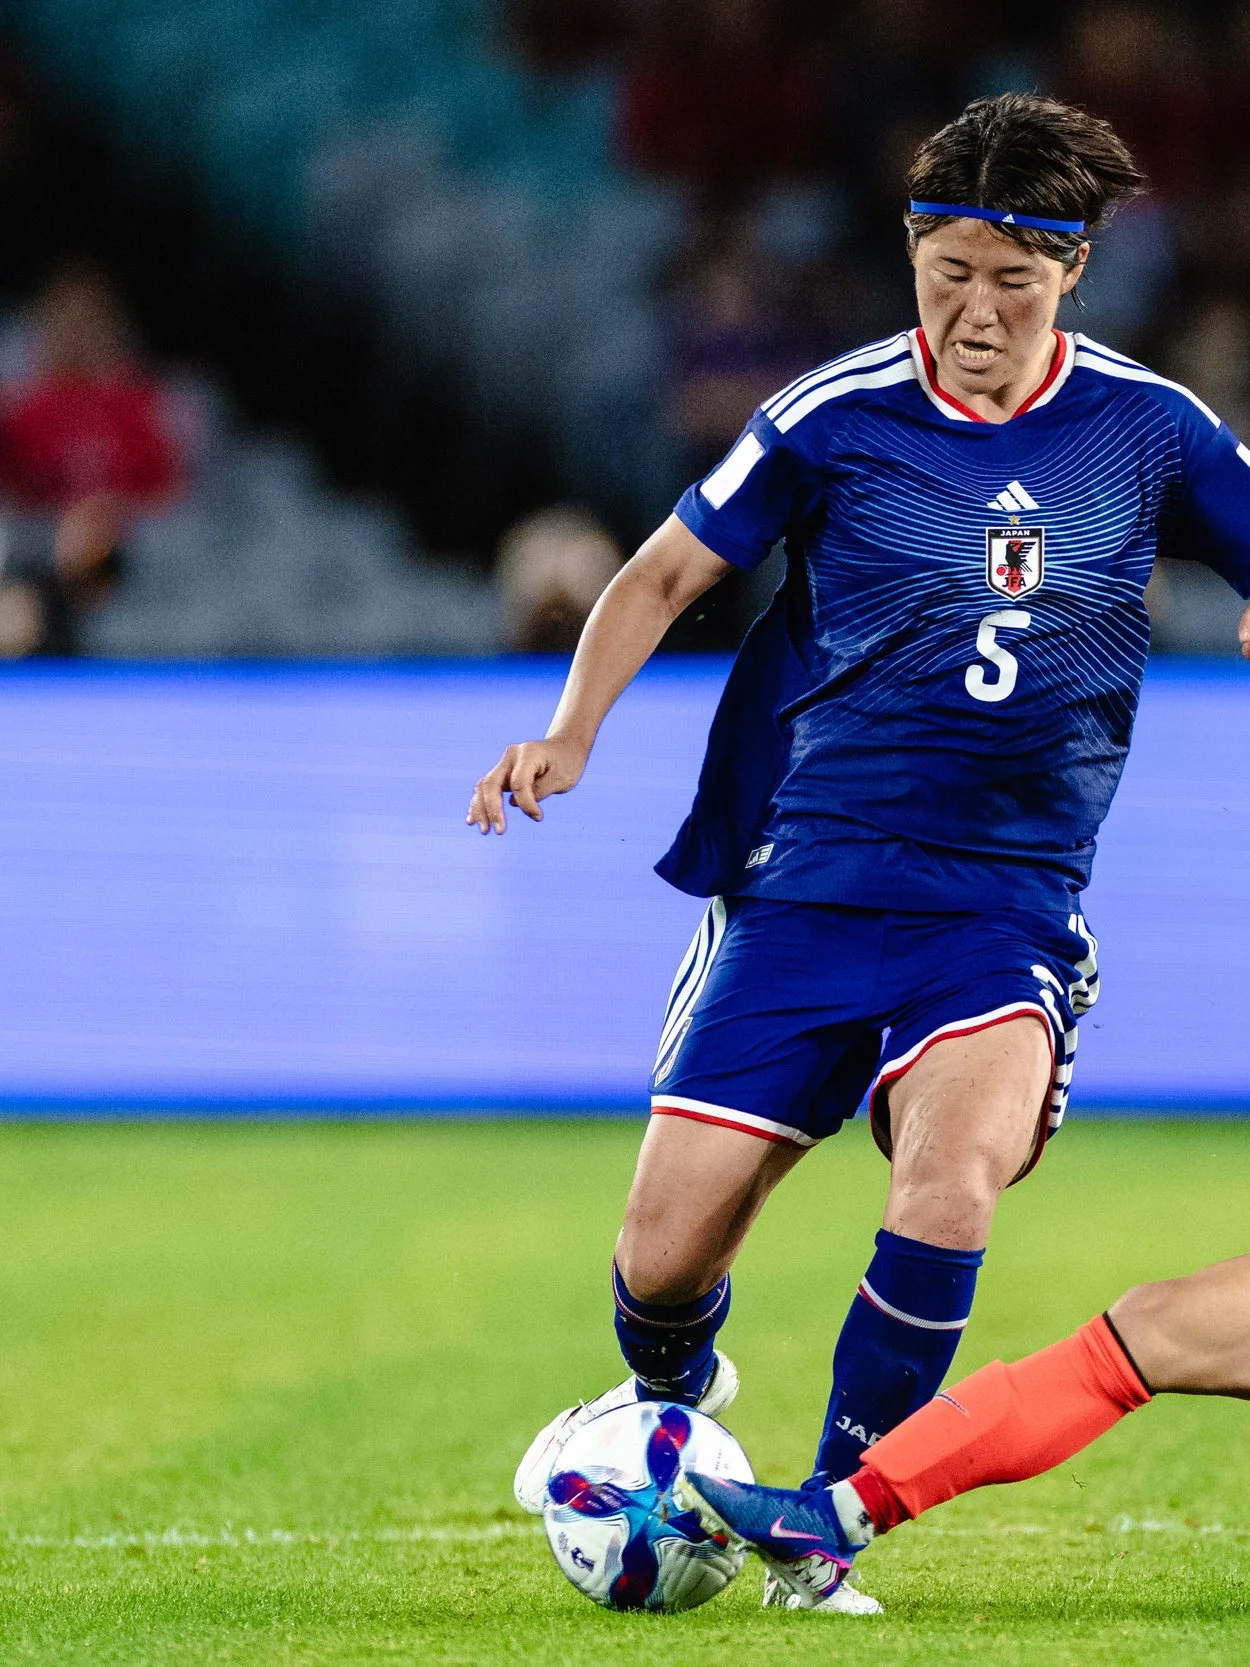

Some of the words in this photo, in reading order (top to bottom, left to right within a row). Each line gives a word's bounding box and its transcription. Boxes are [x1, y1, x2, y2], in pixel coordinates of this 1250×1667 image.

[1000, 529, 1030, 537] JAPAN
[1002, 577, 1027, 588] JFA
[964, 609, 1032, 703] 5
